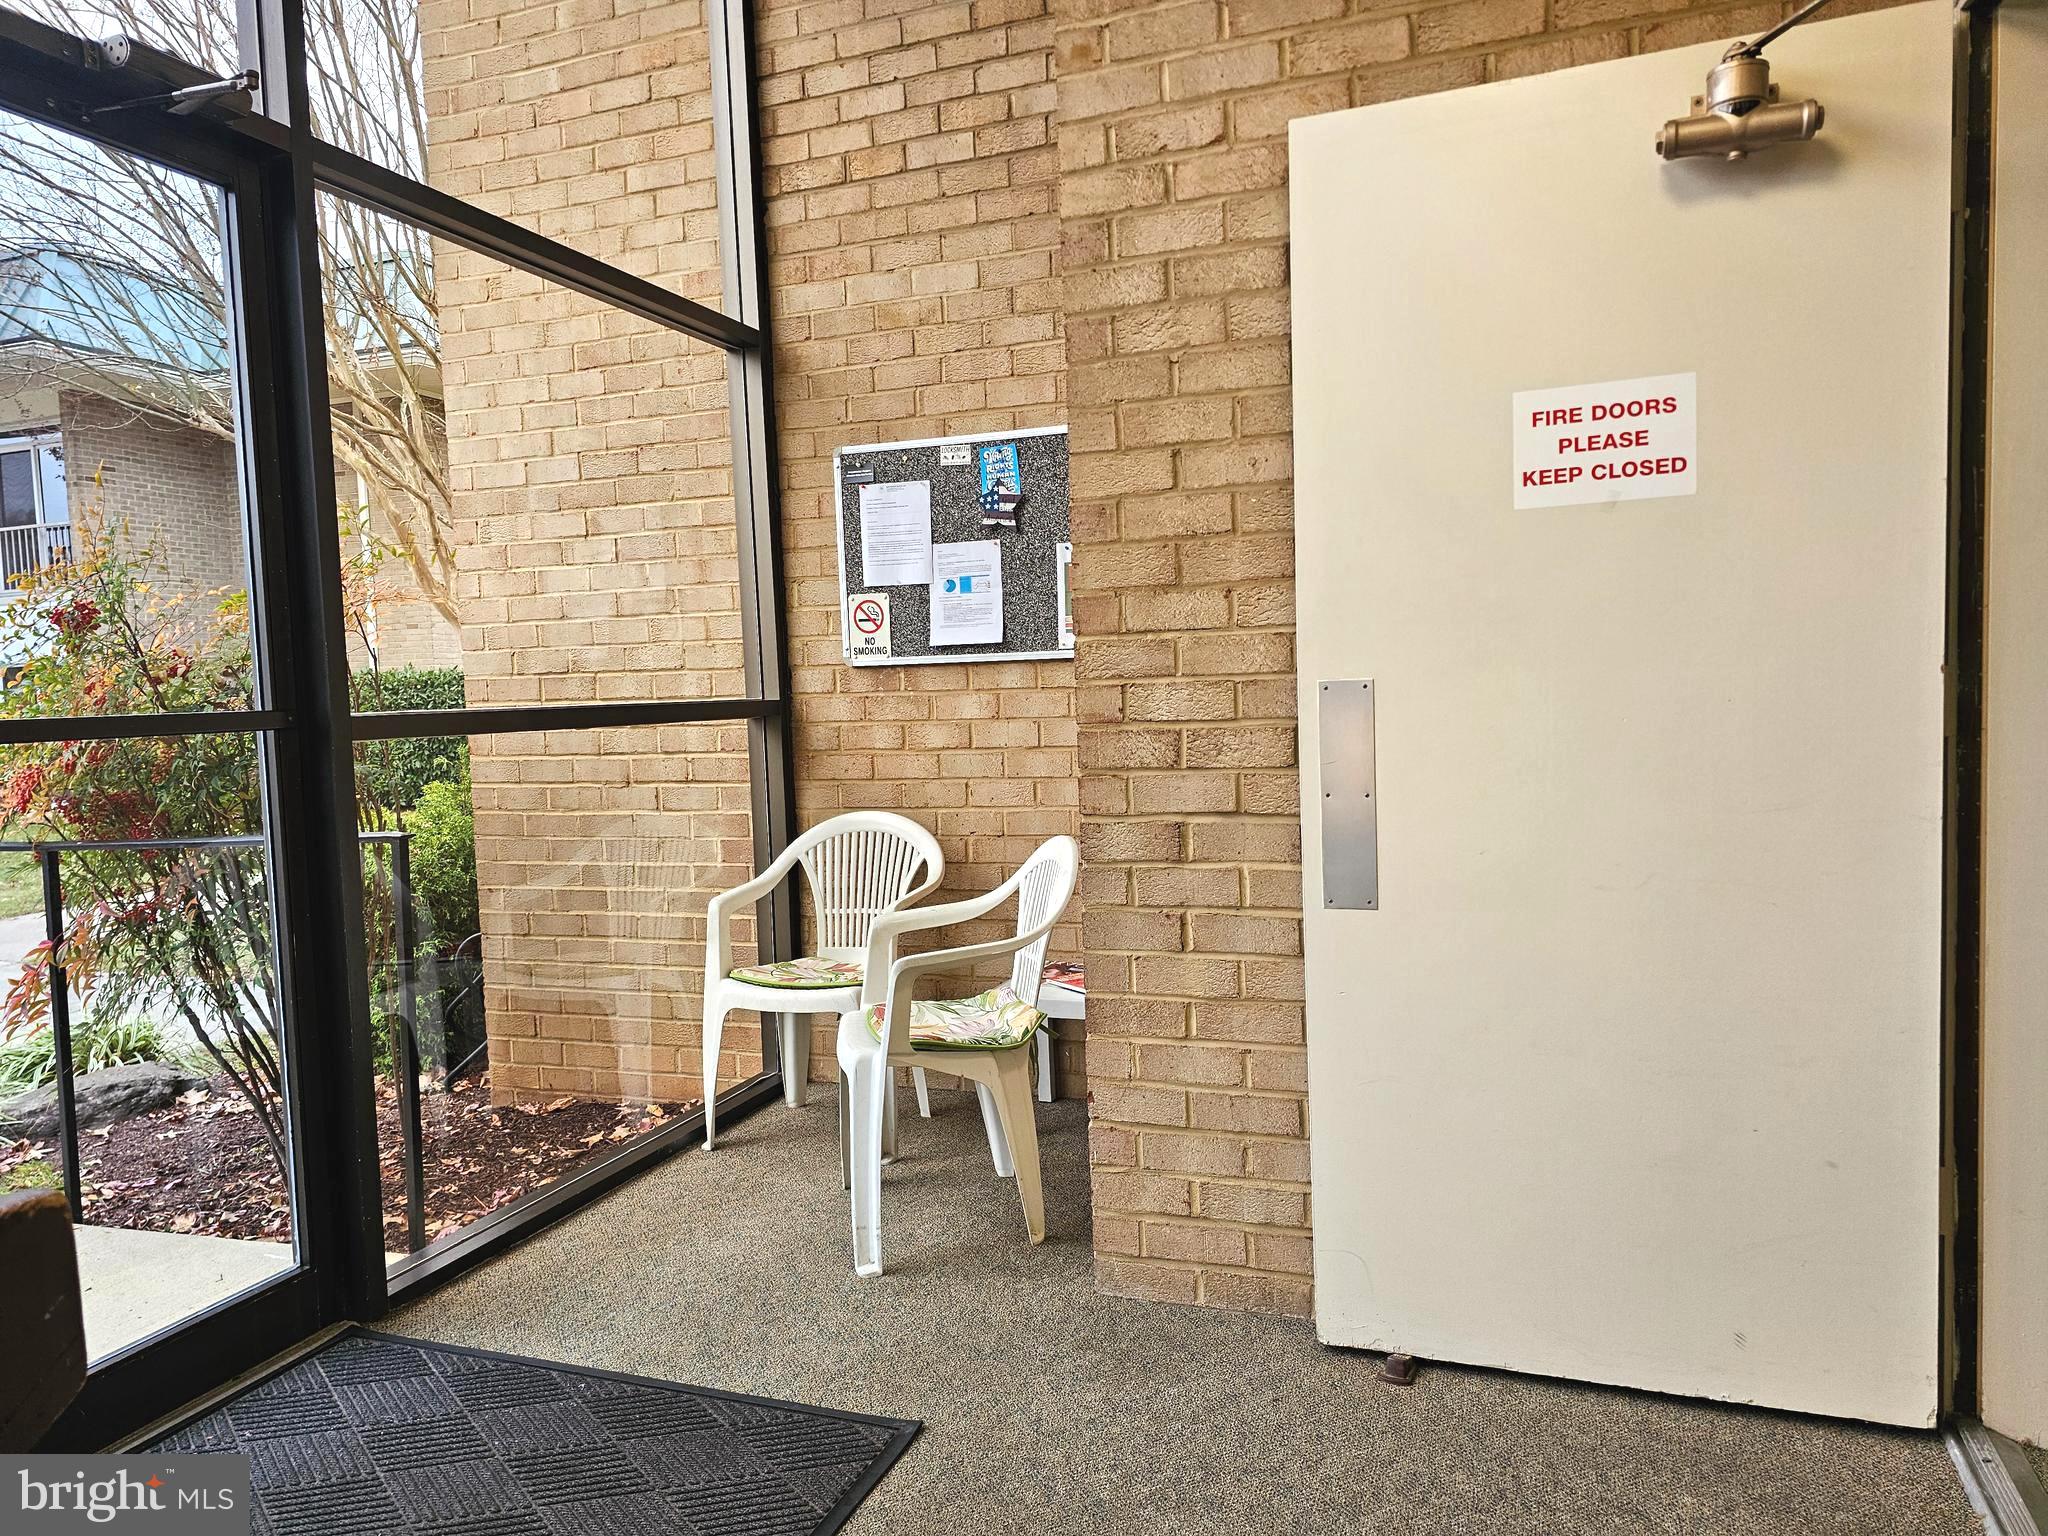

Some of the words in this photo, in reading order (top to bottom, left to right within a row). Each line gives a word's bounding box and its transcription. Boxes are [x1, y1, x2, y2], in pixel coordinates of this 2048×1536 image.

[1532, 407, 1583, 428] FIRE
[1591, 396, 1677, 422] DOORS
[1559, 430, 1649, 454] PLEASE
[941, 446, 970, 454] LOCKSMITH
[986, 471, 1015, 480] HUMAN
[1523, 466, 1583, 488] KEEP
[1591, 456, 1687, 480] CLOSED
[864, 637, 876, 646] NO
[853, 646, 888, 656] SMOKING
